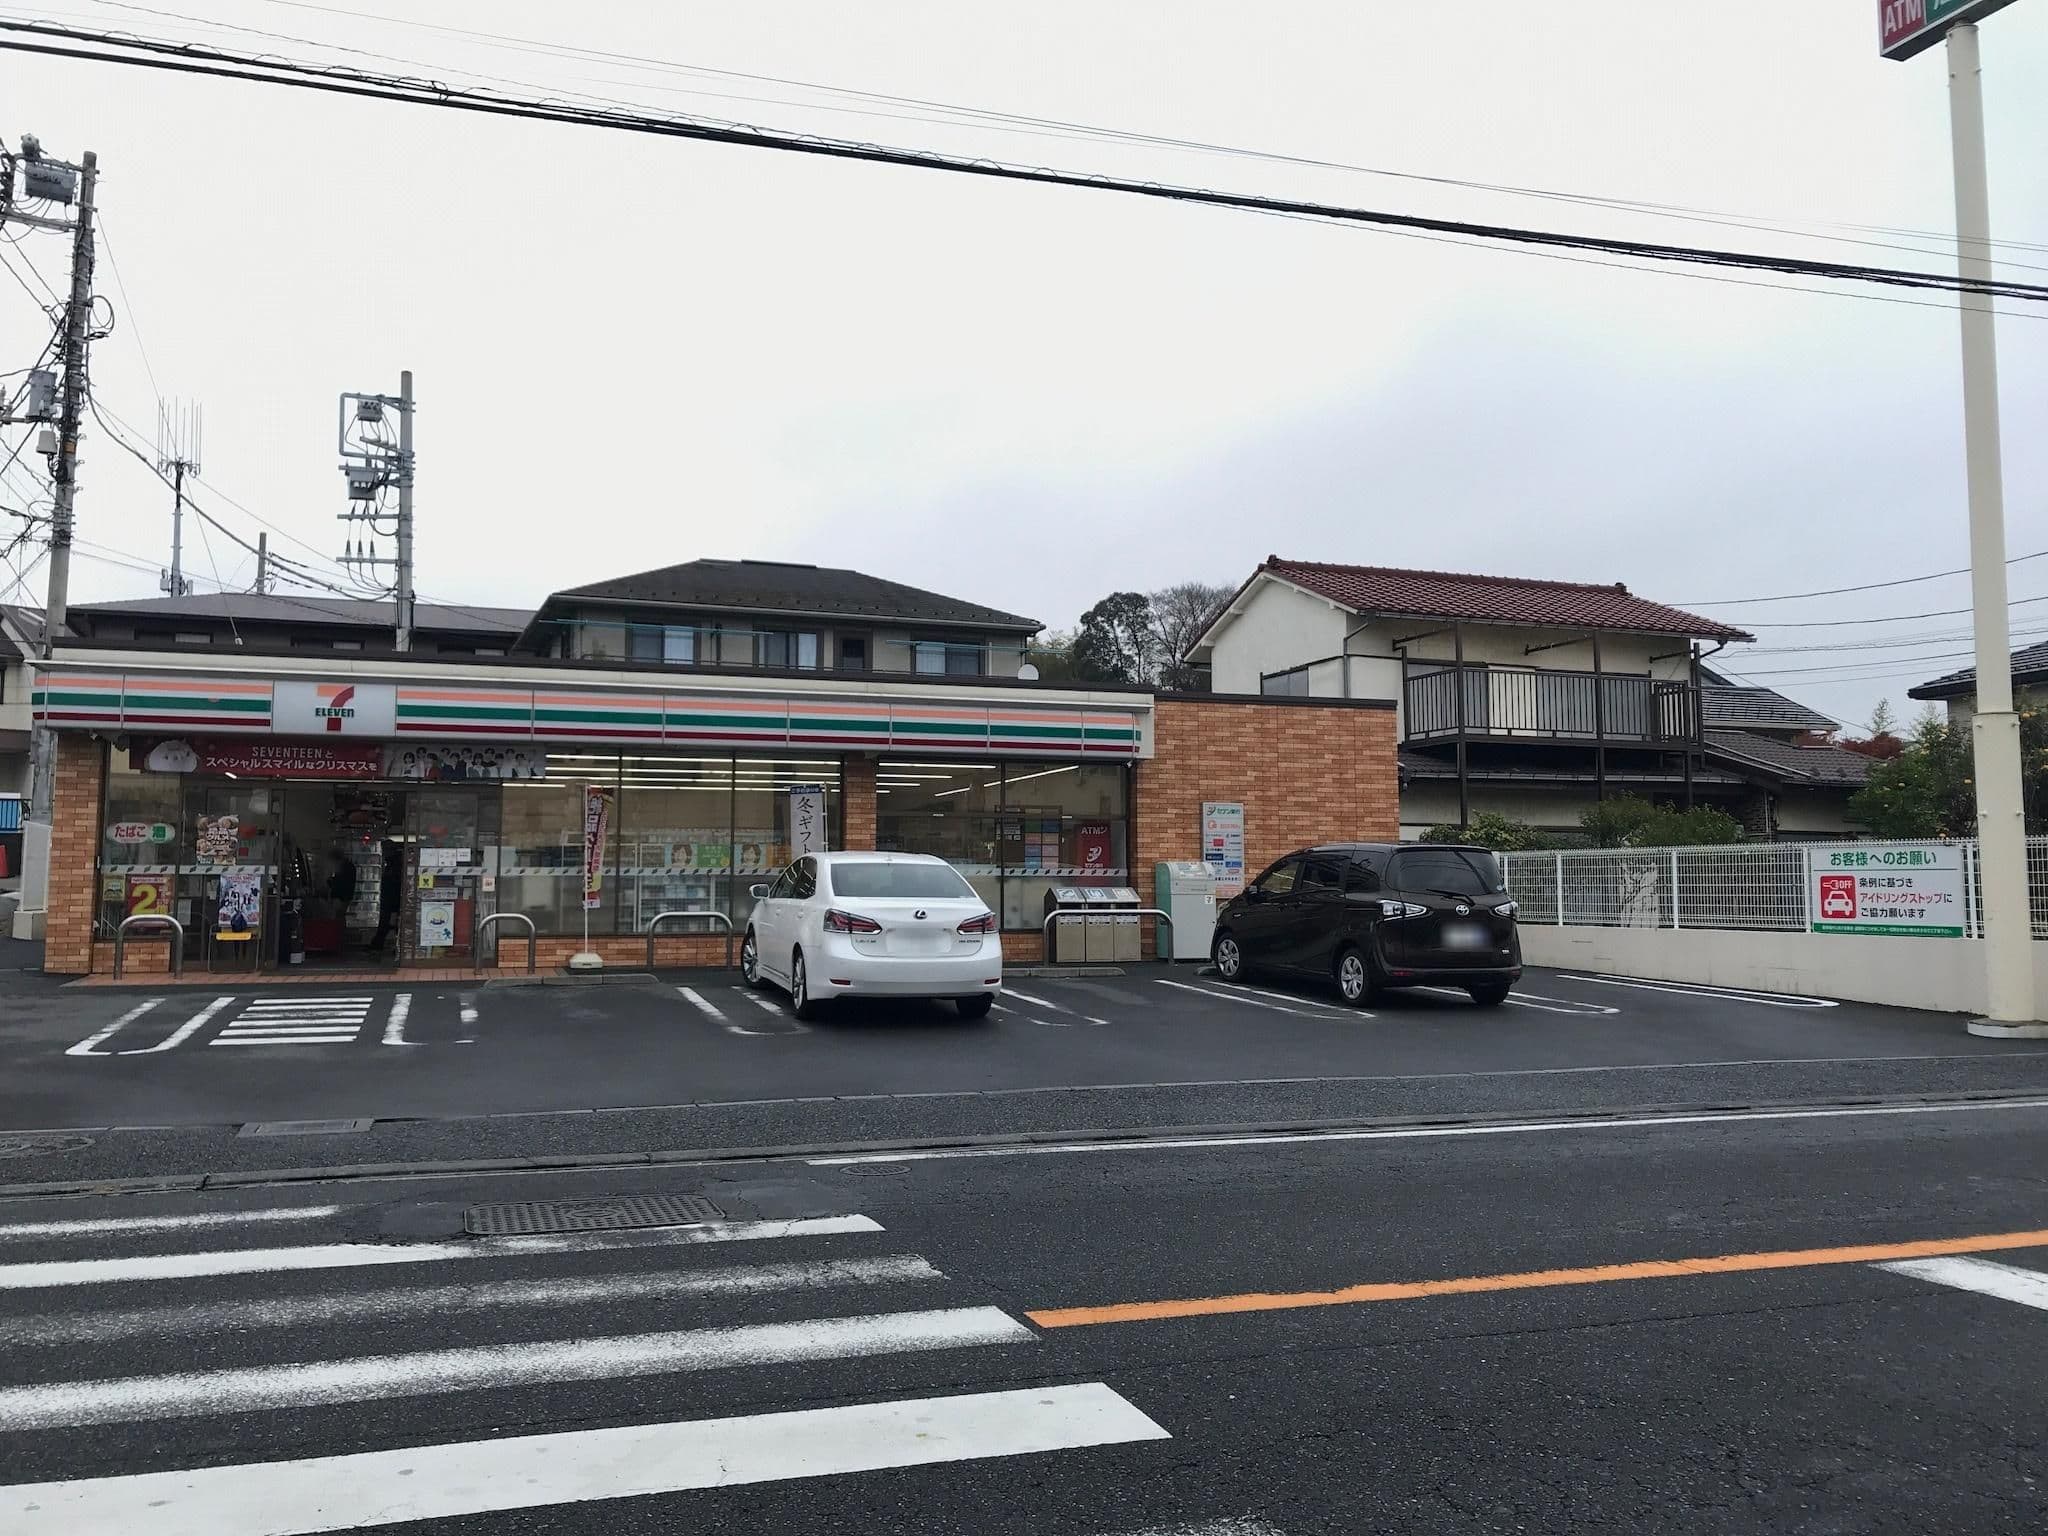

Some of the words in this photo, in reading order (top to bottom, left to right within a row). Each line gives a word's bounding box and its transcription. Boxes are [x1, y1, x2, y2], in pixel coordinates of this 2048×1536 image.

[1884, 0, 1921, 37] ATM
[206, 757, 378, 771] スペシャルスマイルなクリスマスを
[114, 824, 146, 838] たばこ
[1830, 851, 1937, 866] お客様へのお願い
[1839, 880, 1853, 889] OFF
[1859, 878, 1913, 888] 条例に基づき
[1860, 893, 1953, 904] アイドリングストップに
[1861, 908, 1926, 918] ご協力願います
